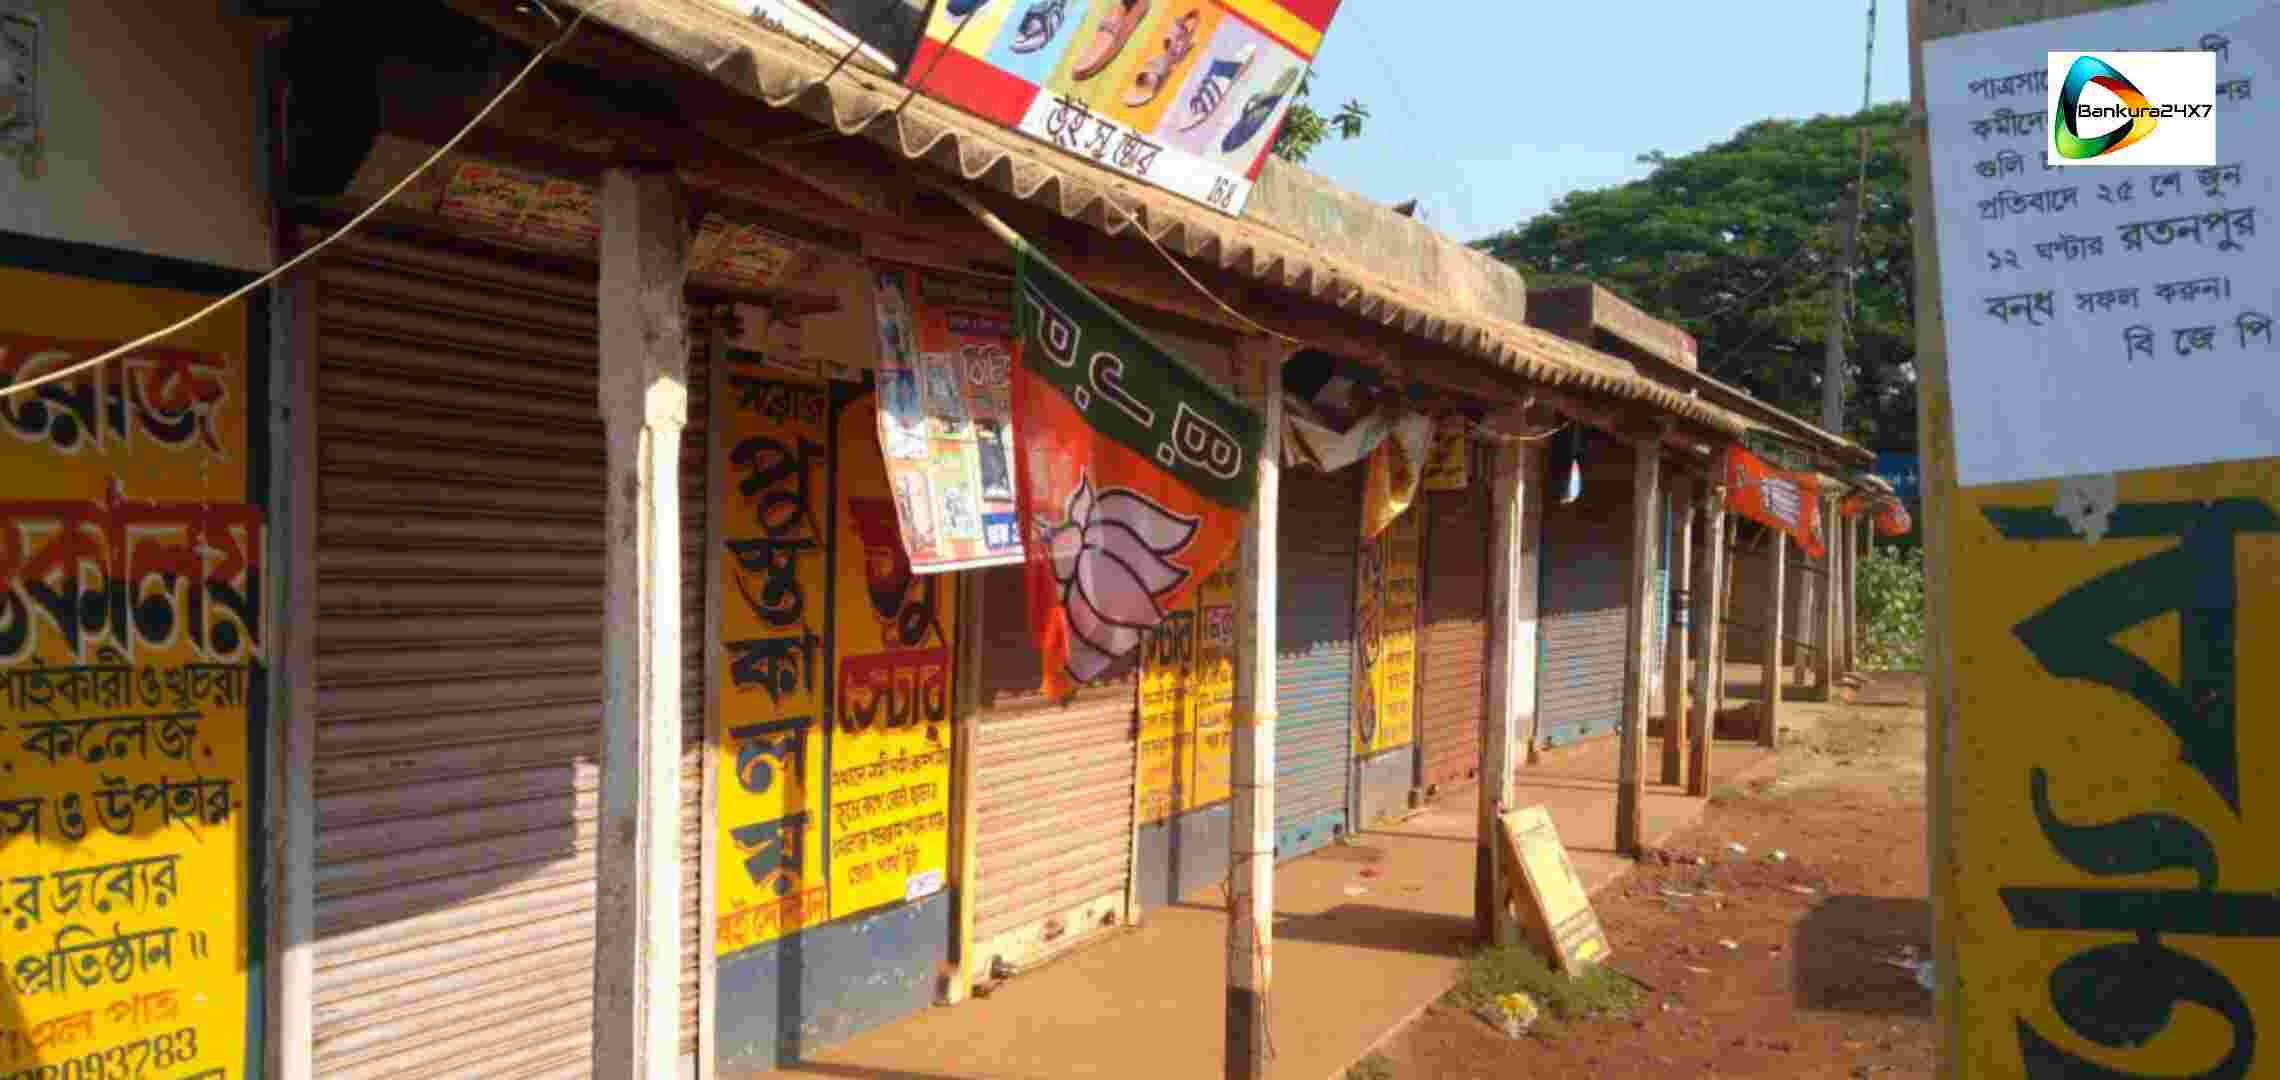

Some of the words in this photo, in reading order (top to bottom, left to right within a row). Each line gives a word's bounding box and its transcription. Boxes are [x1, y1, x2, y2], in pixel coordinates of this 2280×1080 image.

[1973, 150, 2025, 181] গুলি
[1976, 185, 2079, 222] প্রতিবাদে
[2096, 180, 2136, 206] ২৫
[2194, 162, 2243, 198] জুন
[1986, 249, 2024, 272] ১২
[2115, 205, 2258, 253] রতনপুর
[2075, 285, 2141, 315] সফল
[2122, 324, 2157, 361] বি
[2170, 322, 2218, 357] জে
[2234, 310, 2275, 350] পি
